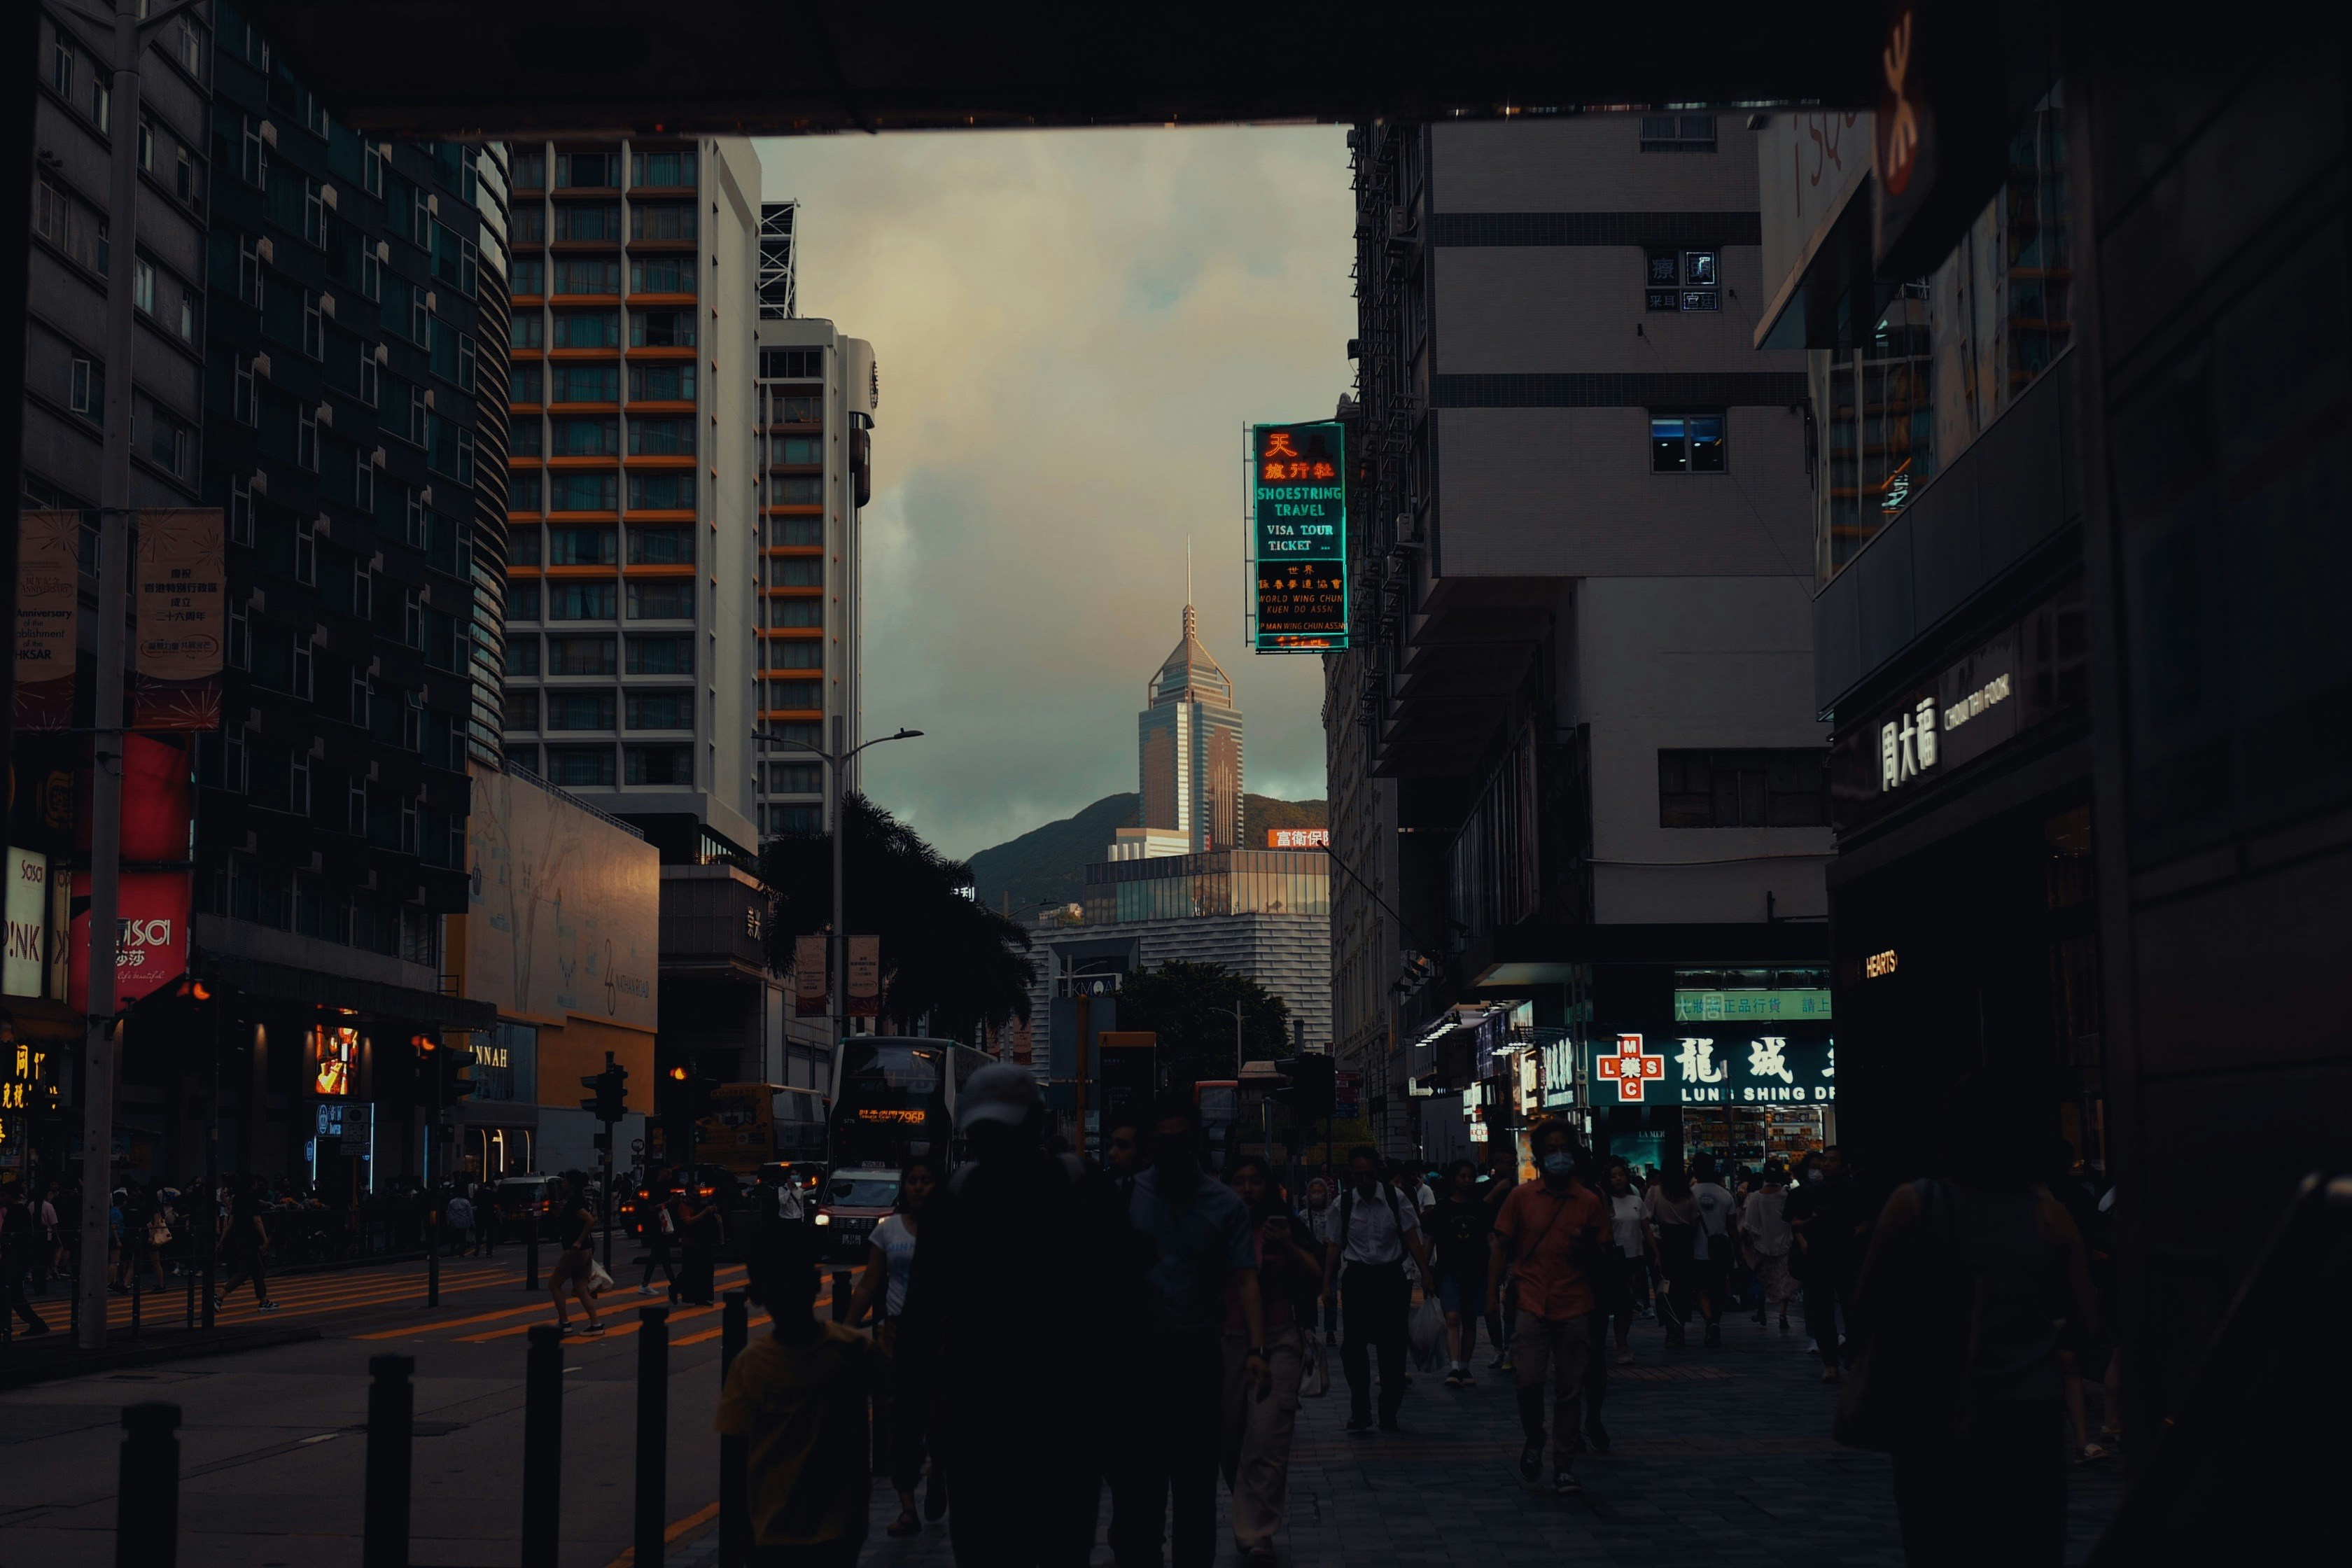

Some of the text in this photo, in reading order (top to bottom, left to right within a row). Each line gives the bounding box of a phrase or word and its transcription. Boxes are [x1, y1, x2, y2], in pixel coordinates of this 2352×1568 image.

[1265, 462, 1334, 479] 旅行社
[1257, 487, 1342, 500] SHOESTRING
[1275, 503, 1325, 517] TRAVEL
[1267, 525, 1334, 536] VISA TOUR
[1268, 540, 1311, 551] TICKET
[171, 568, 192, 579] 慶祝
[1287, 564, 1314, 575] 世界
[145, 582, 218, 594] 香港特別行政區
[171, 597, 191, 608] 成立
[1320, 594, 1343, 603] CHUN
[16, 608, 72, 620] Anniversary
[155, 611, 206, 622] 二十六周年
[12, 629, 65, 638] ablishment
[15, 649, 52, 660] HKSAR
[1944, 699, 1970, 731] CHOW
[1984, 673, 2010, 708] FOOK
[1882, 697, 1938, 793] 周大福
[22, 860, 43, 883] sasa
[1866, 949, 1896, 979] HEARTS
[1624, 1040, 1637, 1054] M
[1625, 1082, 1637, 1096] C
[1681, 1087, 1735, 1102] LUN
[1744, 1087, 1806, 1100] SHING
[898, 1110, 925, 1124] 796P
